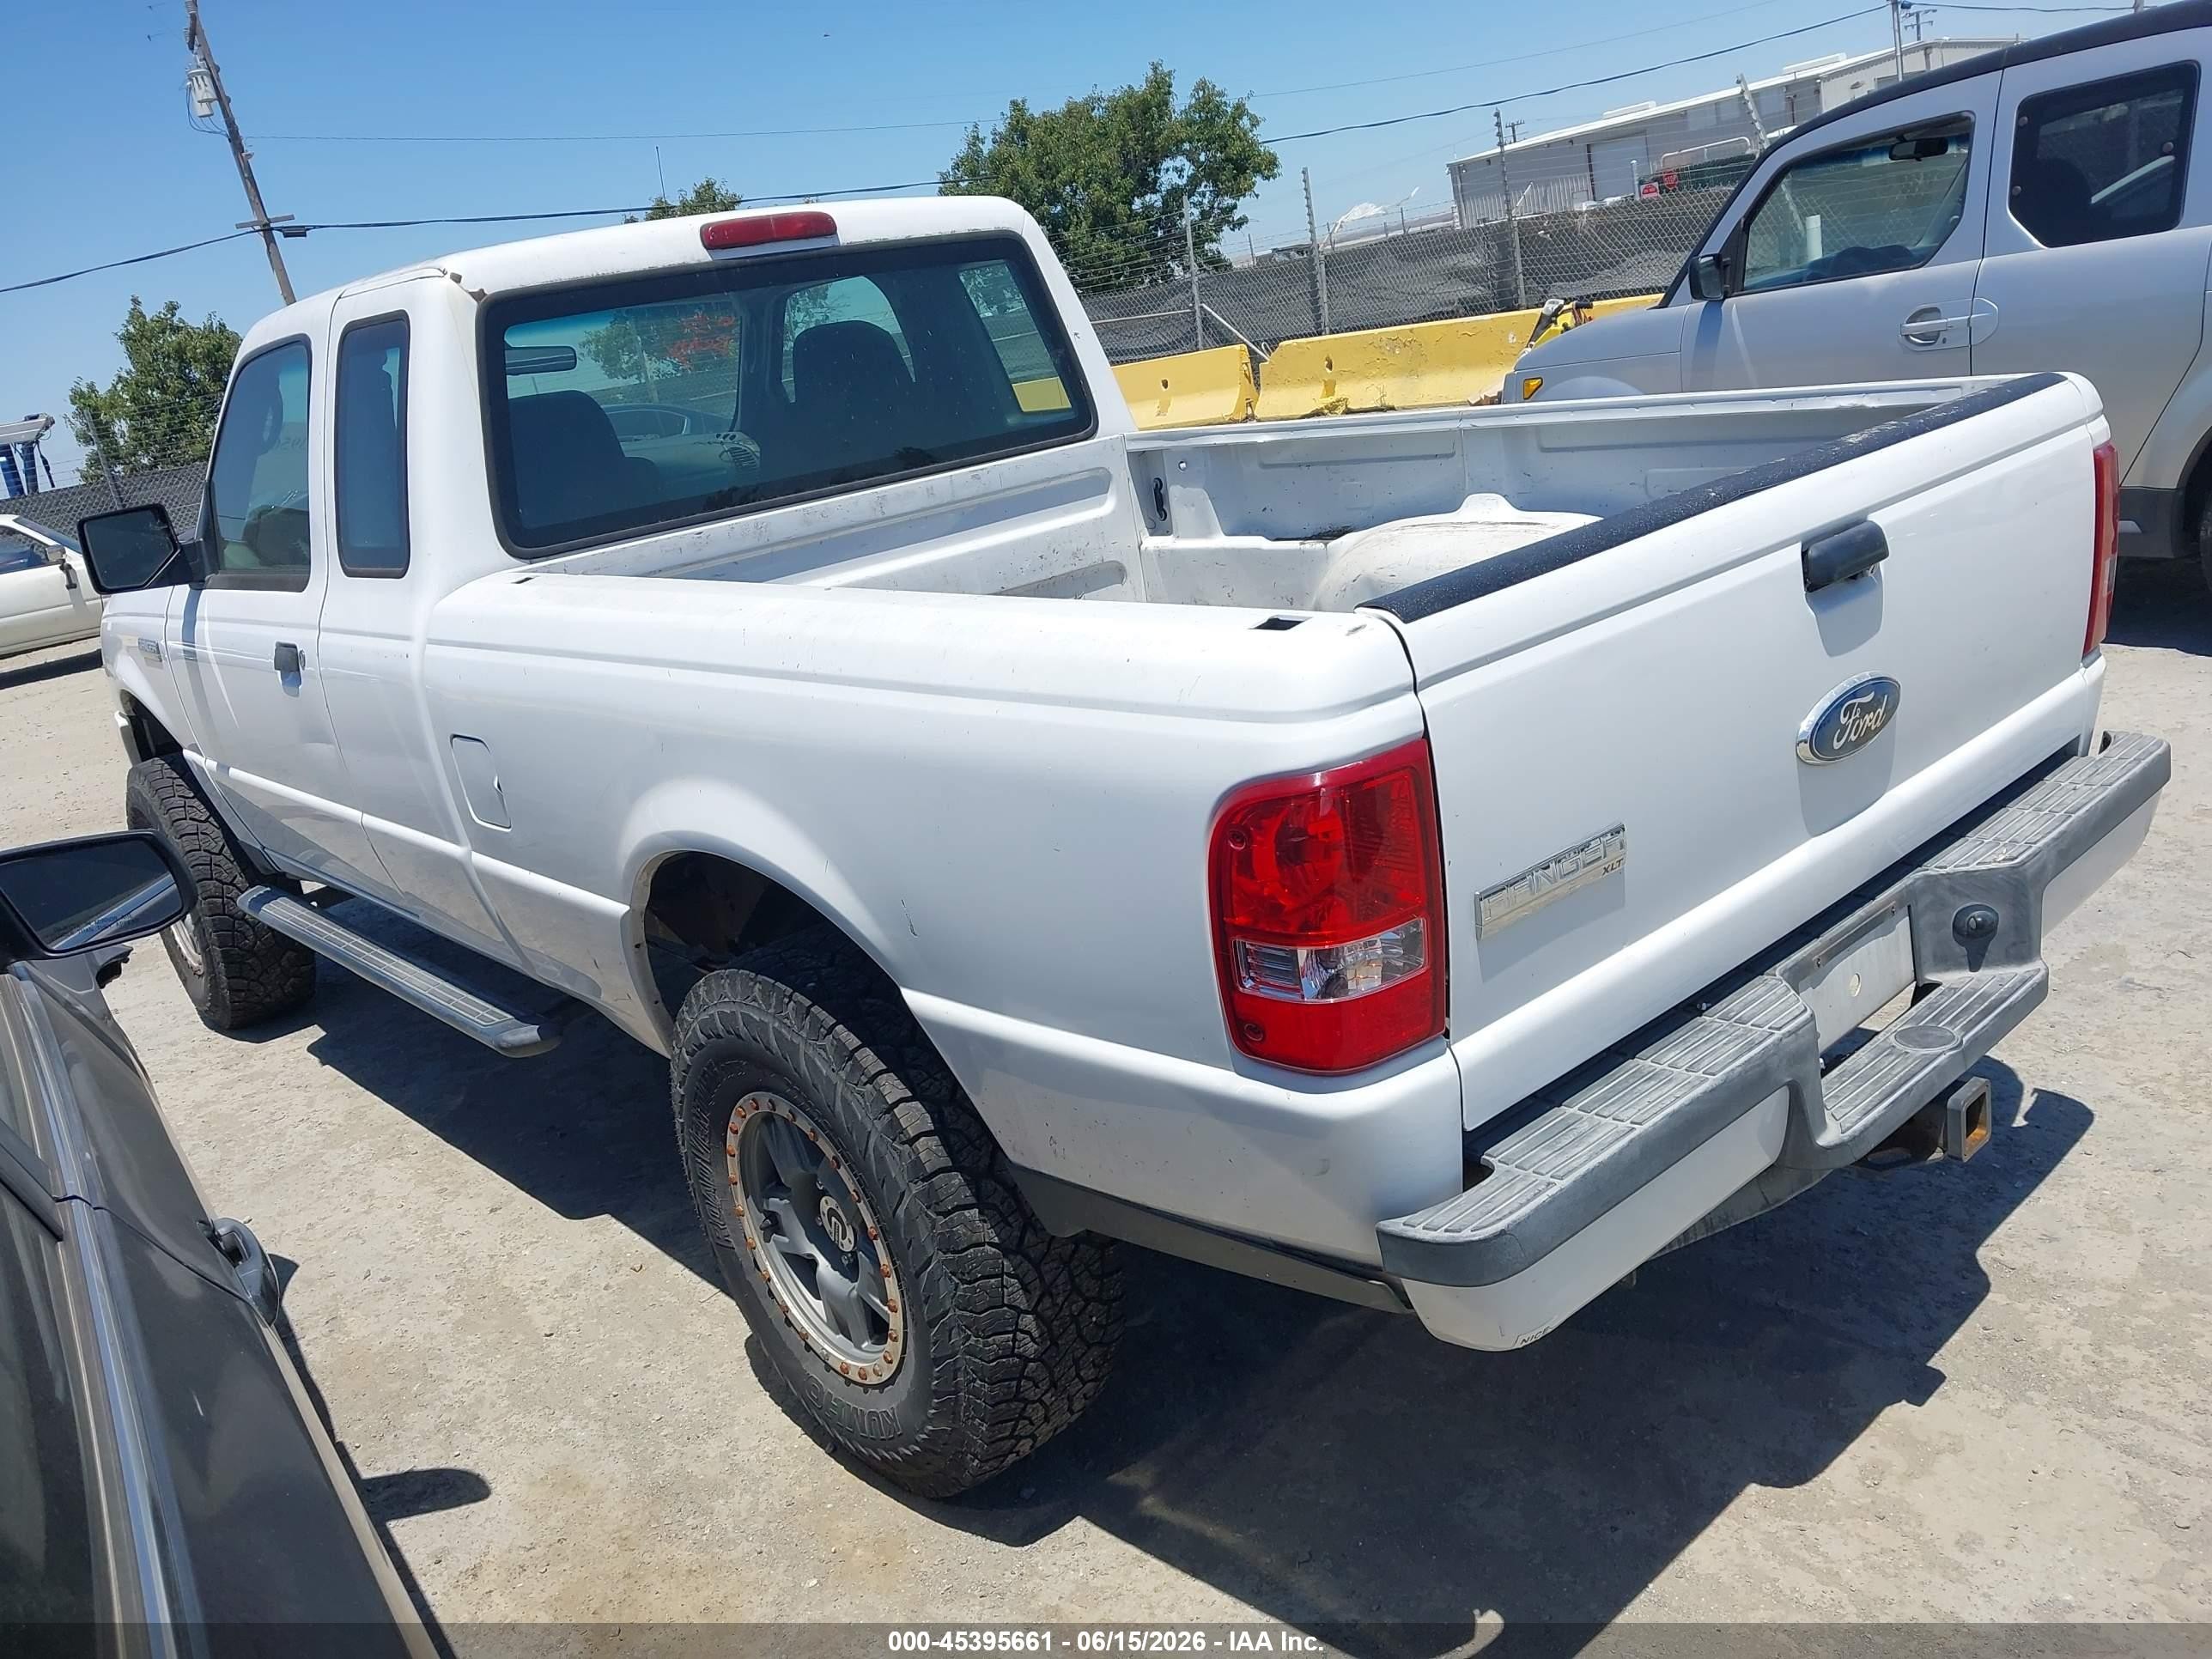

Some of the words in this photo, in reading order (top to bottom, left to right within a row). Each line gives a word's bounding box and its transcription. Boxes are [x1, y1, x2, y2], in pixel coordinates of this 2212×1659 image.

[1832, 690, 1888, 749] Ford
[1482, 830, 1626, 921] RANGER
[1602, 858, 1624, 876] XLT
